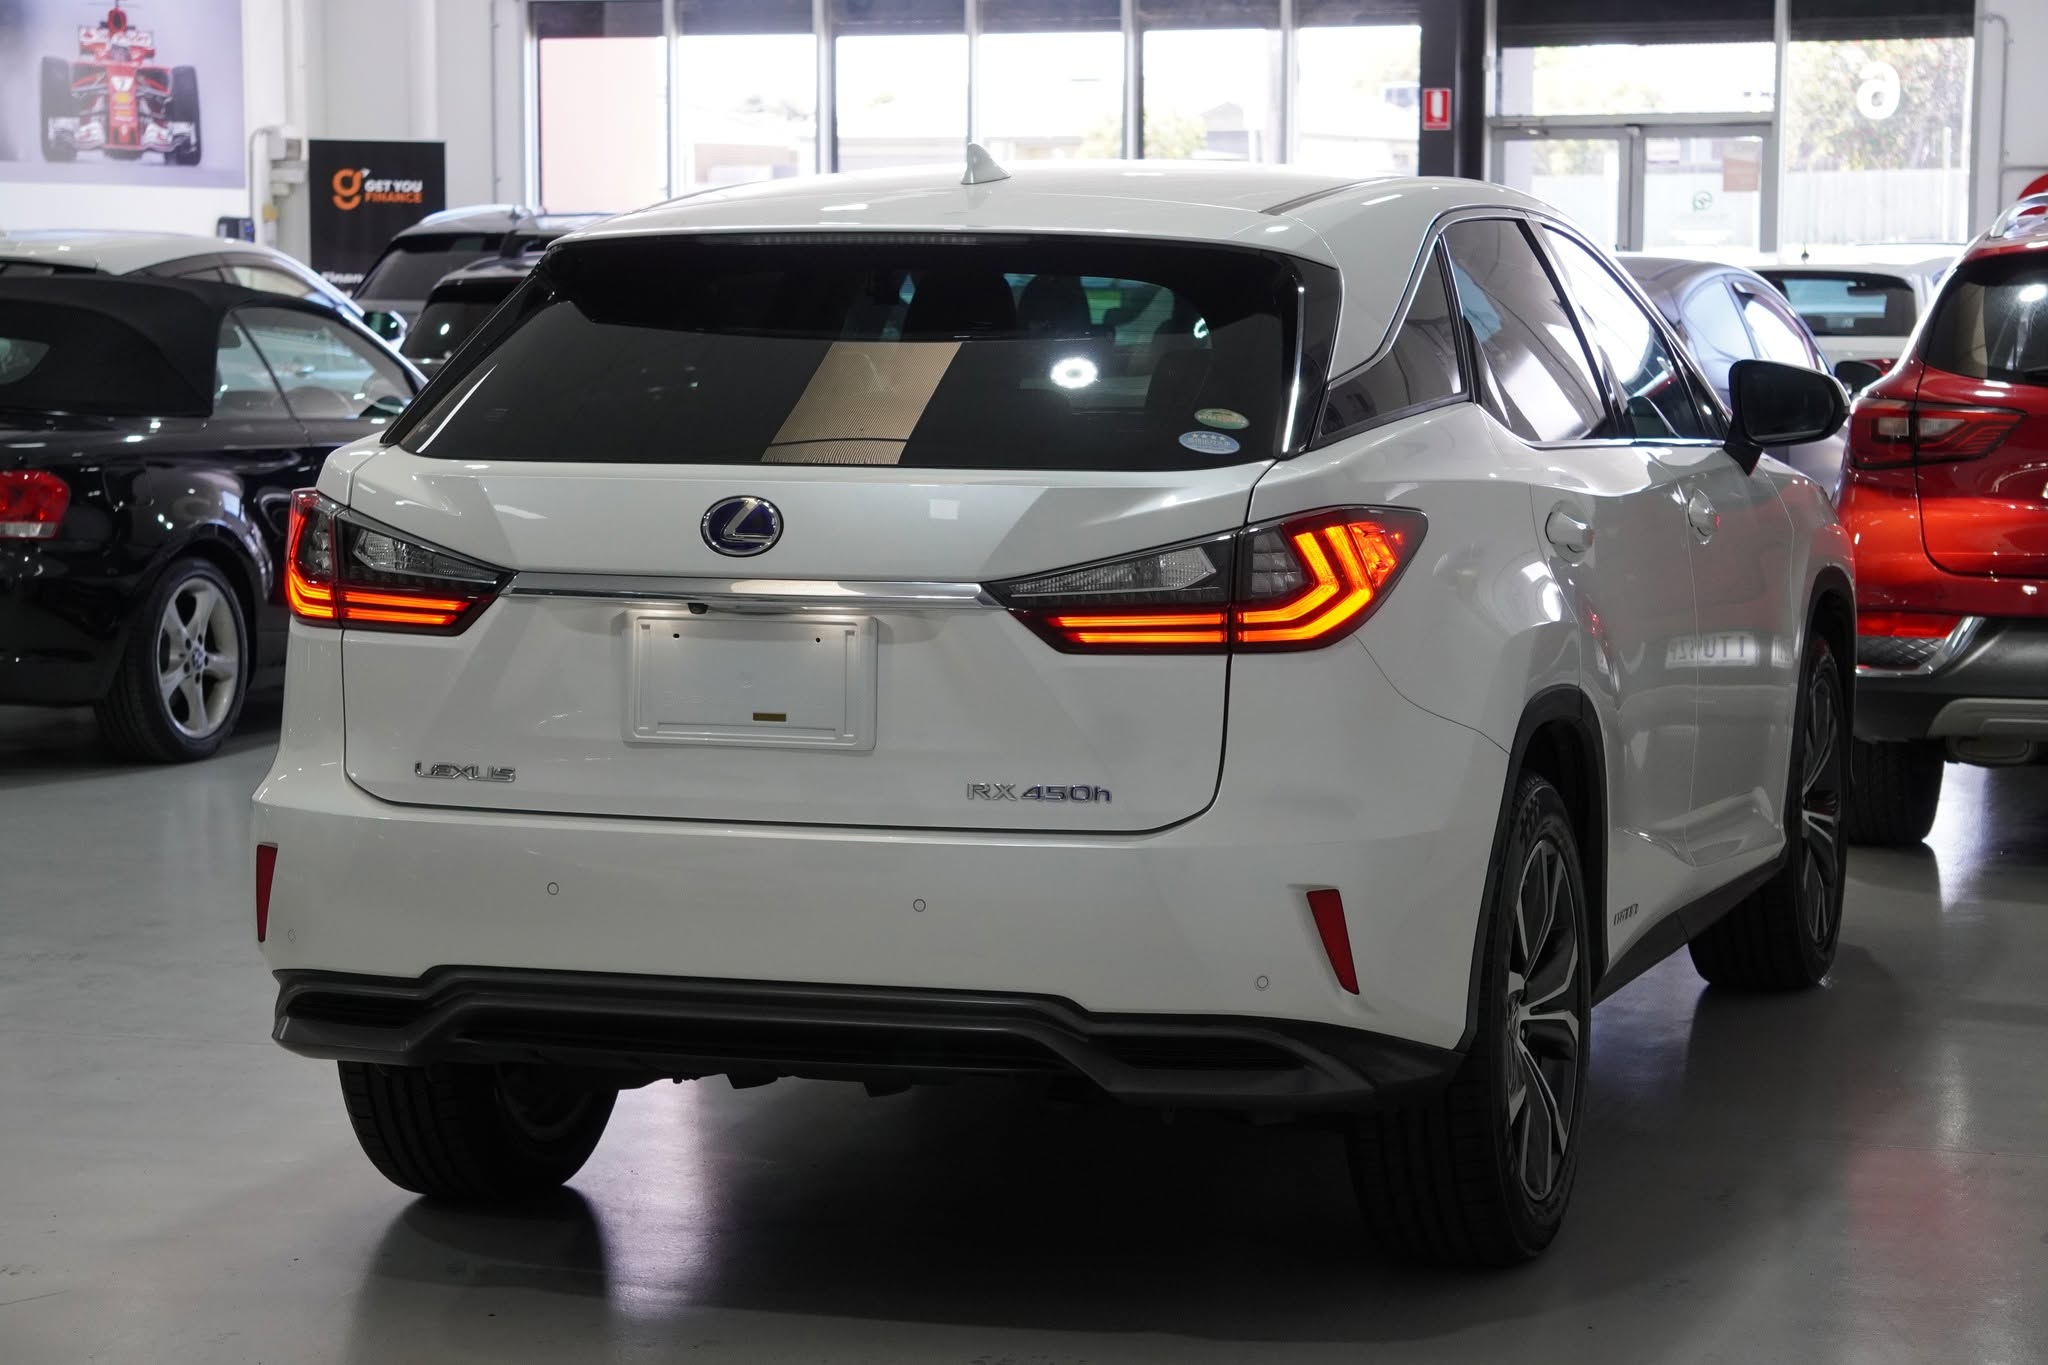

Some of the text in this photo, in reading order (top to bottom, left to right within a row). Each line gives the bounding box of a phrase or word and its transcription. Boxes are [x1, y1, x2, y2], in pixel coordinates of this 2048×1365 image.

[364, 179, 423, 193] GET YOU
[364, 191, 423, 203] FINANCE
[415, 761, 516, 783] LEXUS
[967, 783, 1112, 803] RX 450h
